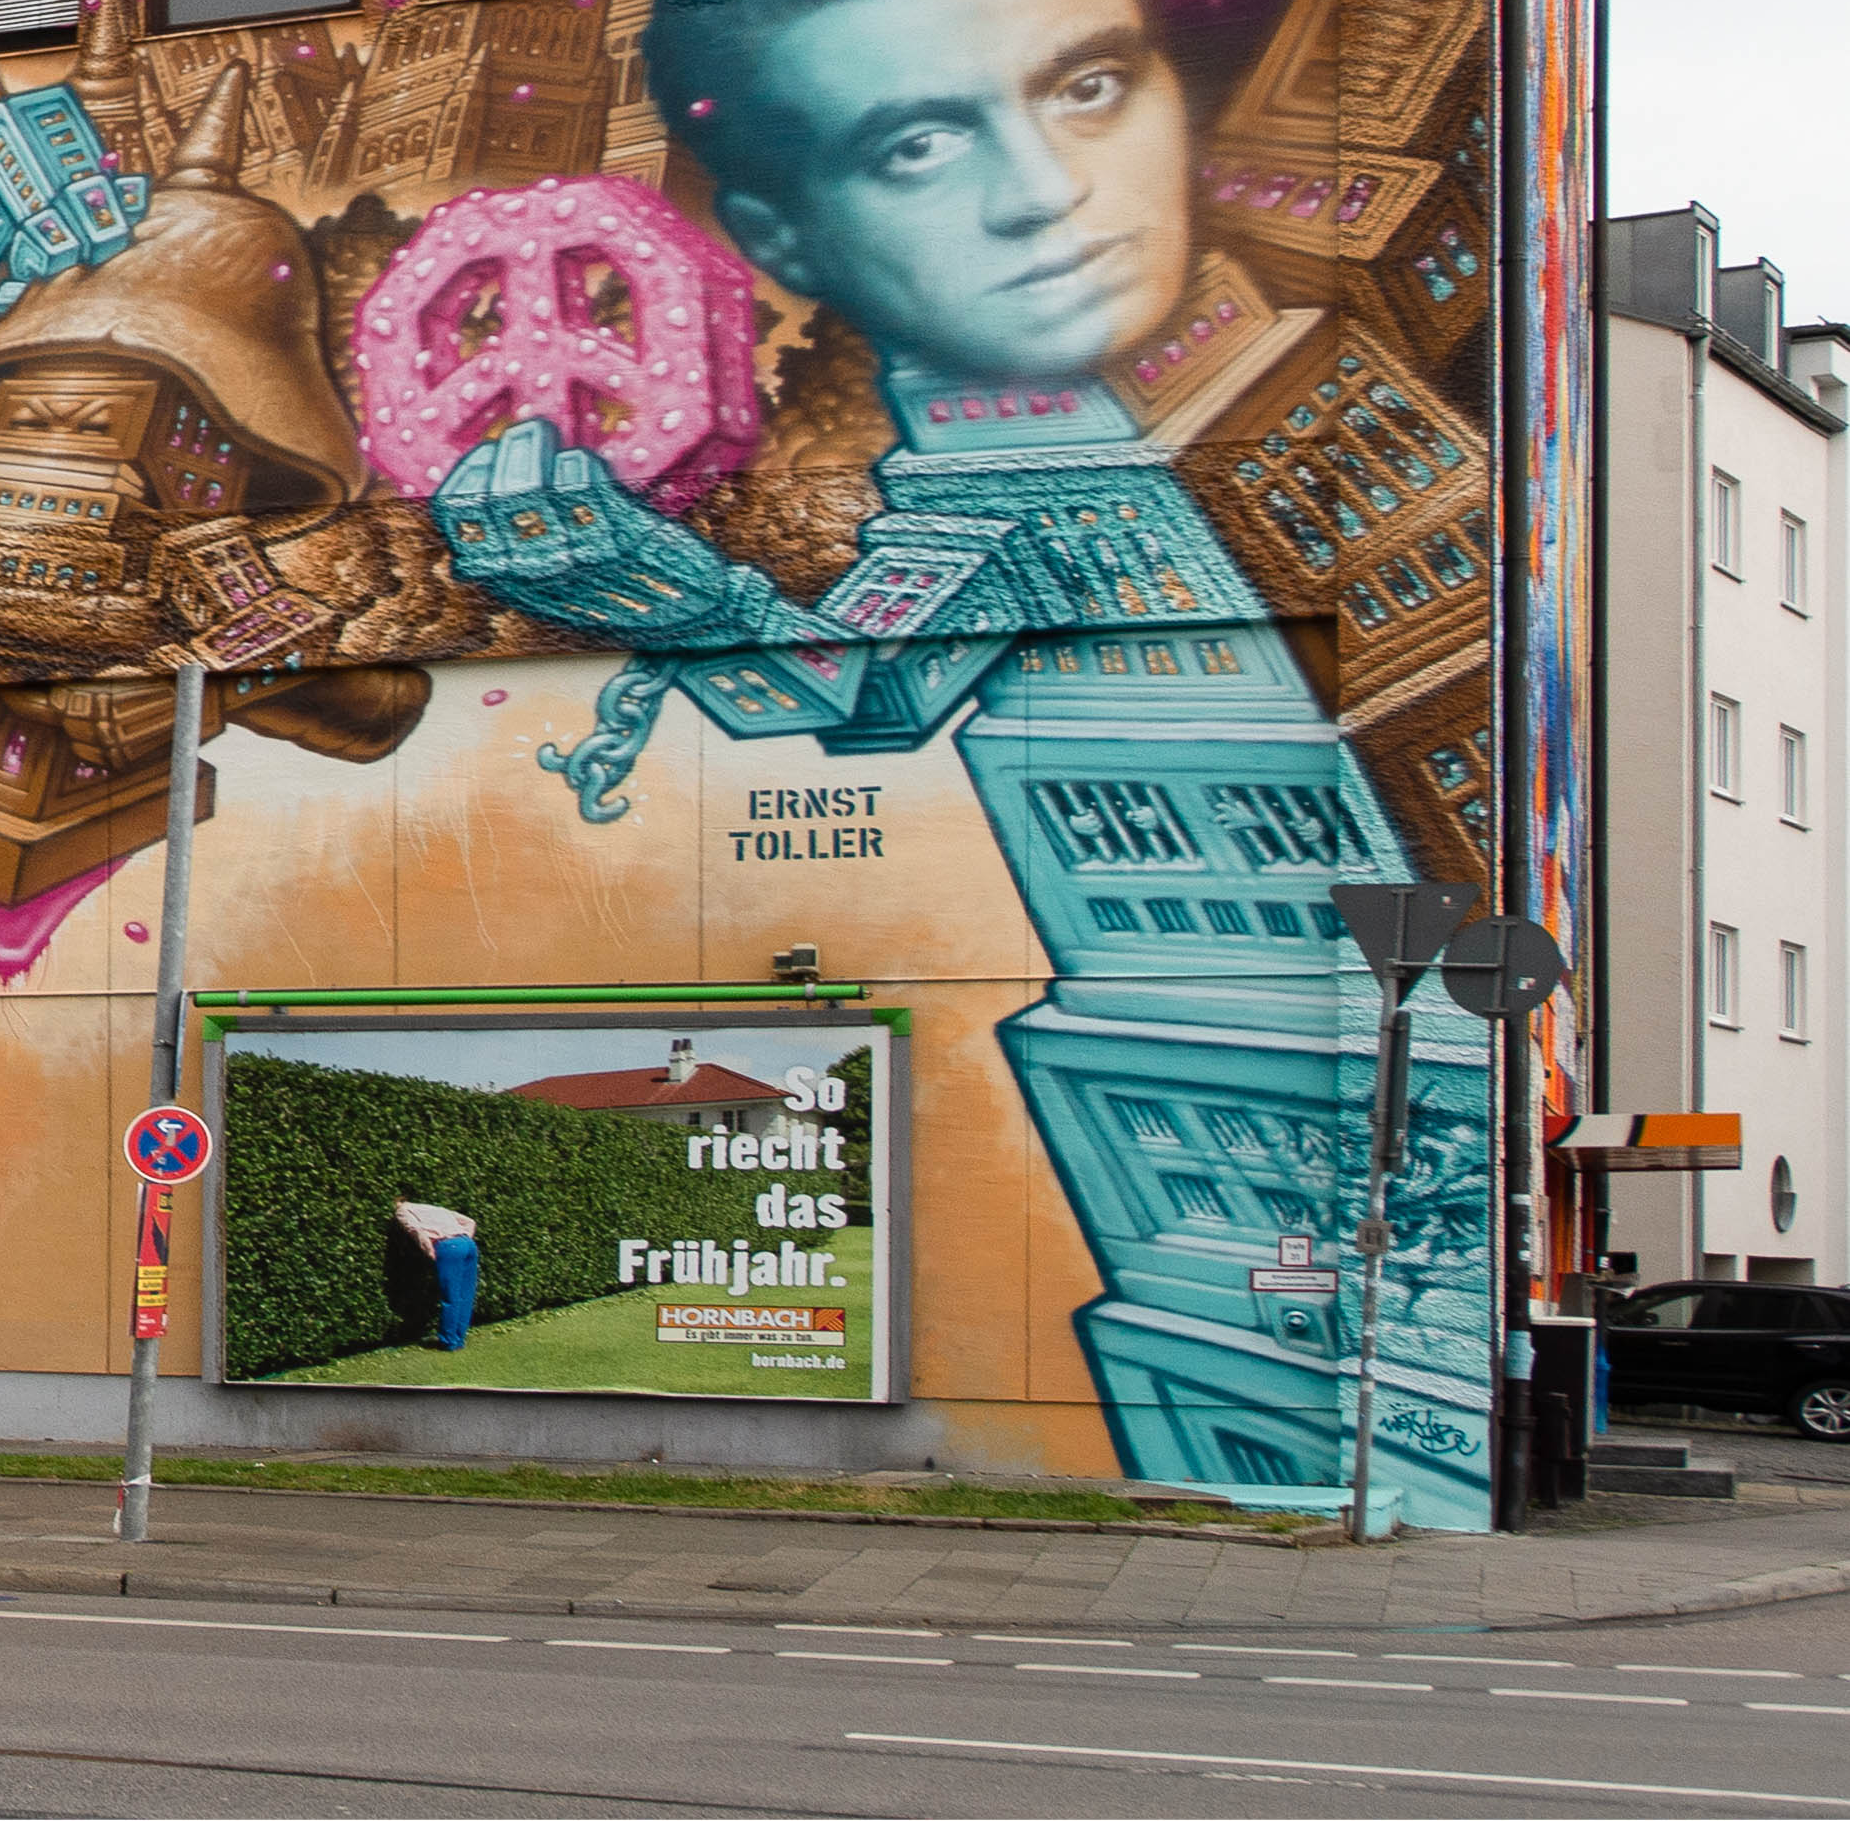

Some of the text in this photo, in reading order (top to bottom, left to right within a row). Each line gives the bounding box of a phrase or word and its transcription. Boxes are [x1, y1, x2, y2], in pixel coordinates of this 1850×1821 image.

[749, 786, 882, 820] ERNST
[728, 828, 884, 861] TOLLER
[784, 1066, 846, 1112] So
[688, 1123, 846, 1170] riecht
[756, 1183, 848, 1229] das
[618, 1239, 847, 1297] Frühjahr.
[660, 1307, 810, 1328] HORNBACH
[685, 1330, 697, 1339] Es
[701, 1330, 721, 1342] gibt
[724, 1331, 754, 1341] immer
[758, 1333, 777, 1341] was
[796, 1332, 815, 1342] tun.
[752, 1352, 846, 1370] hornbach.de
